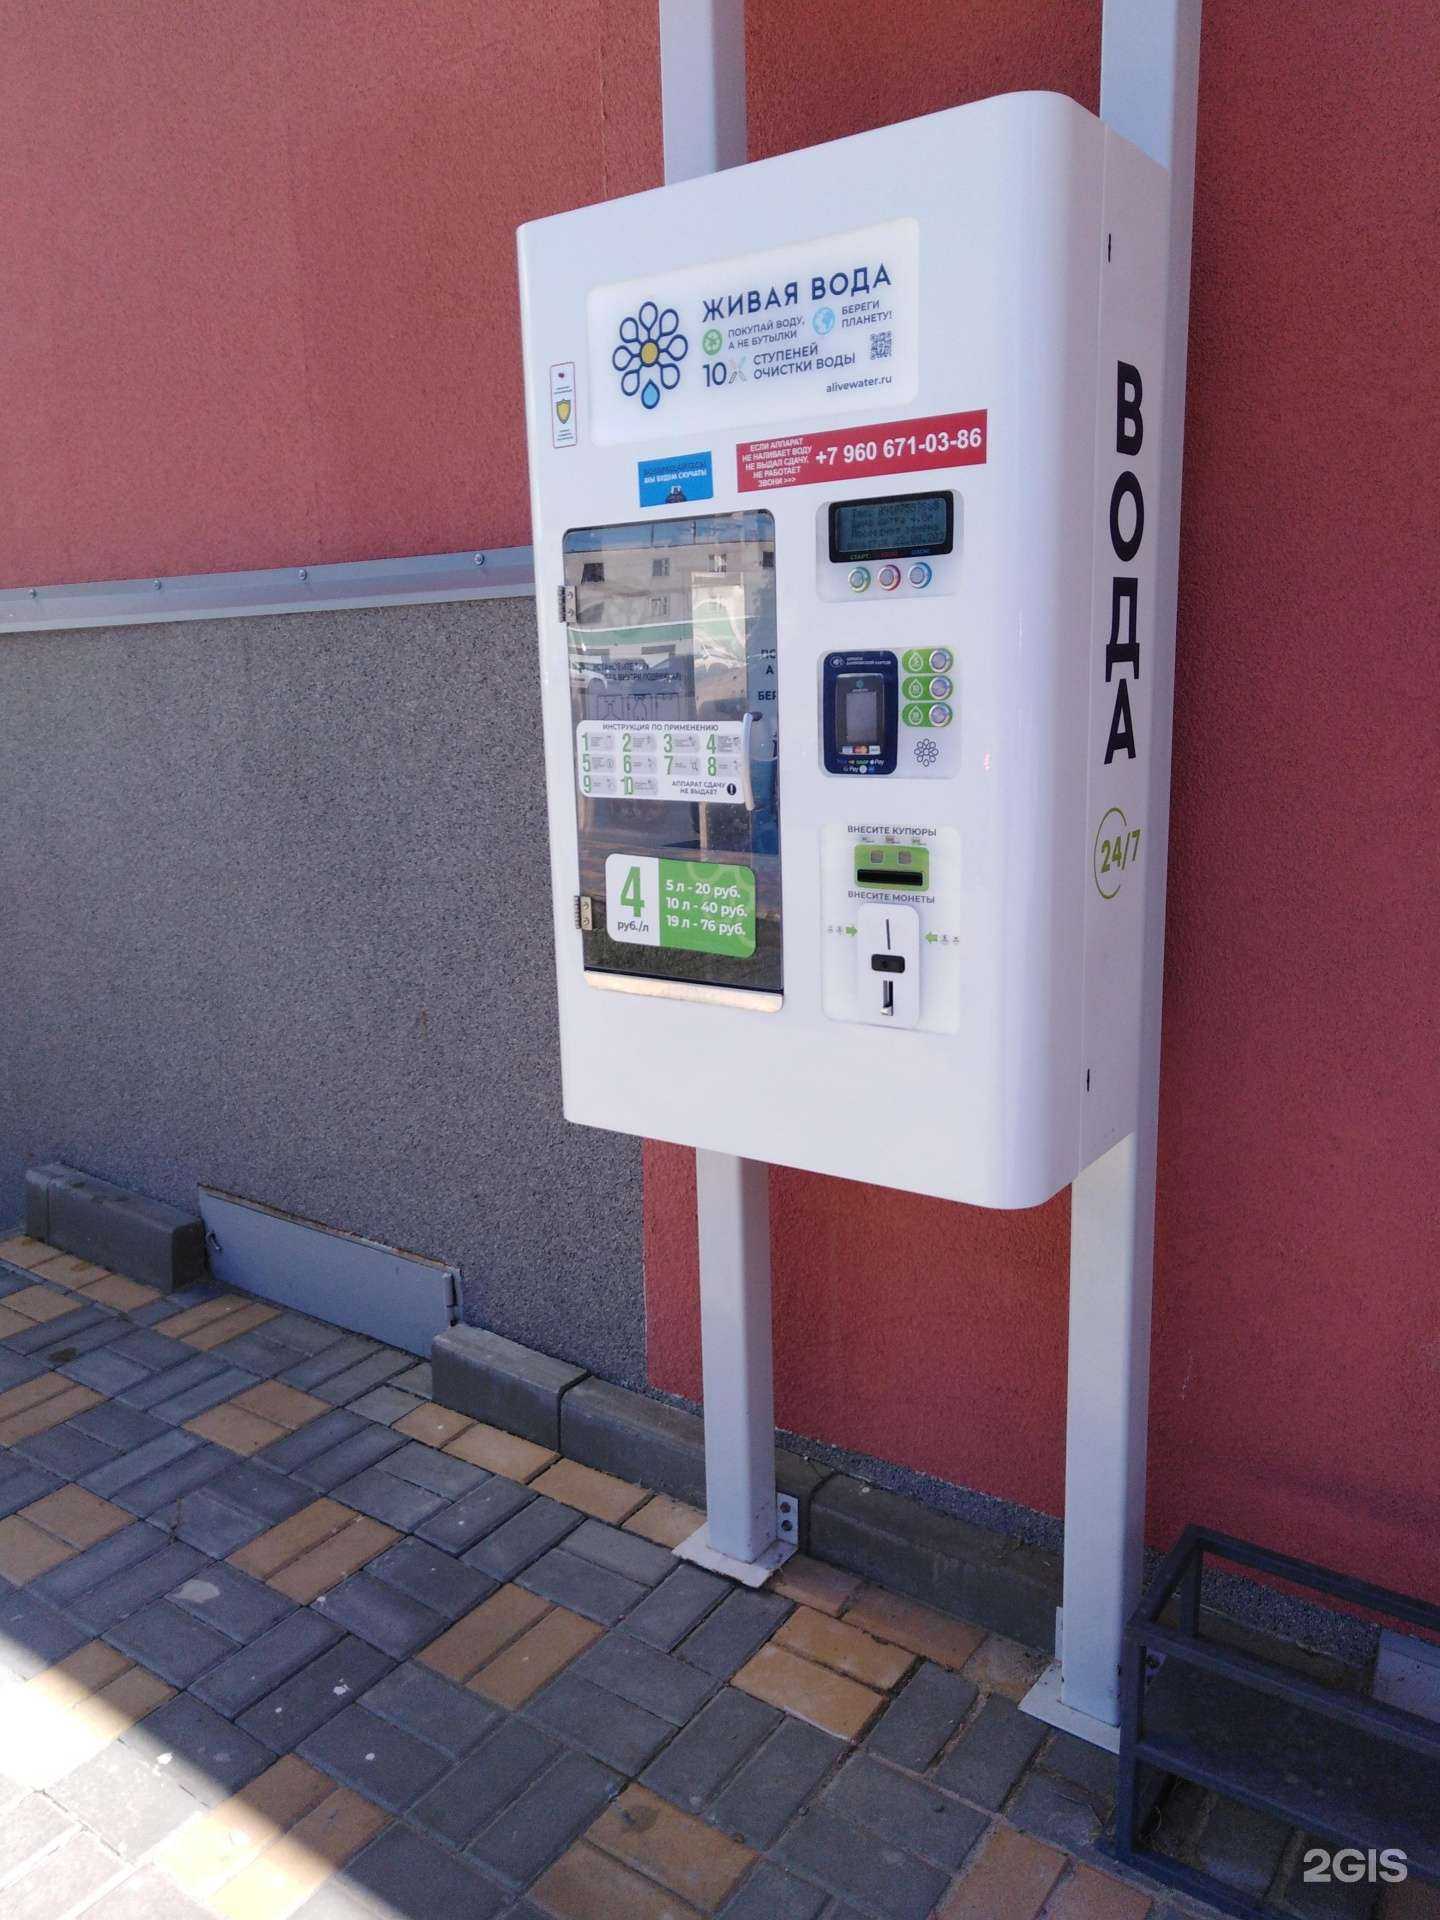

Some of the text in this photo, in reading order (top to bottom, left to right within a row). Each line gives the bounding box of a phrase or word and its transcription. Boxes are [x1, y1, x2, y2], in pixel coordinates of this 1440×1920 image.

[702, 263, 891, 322] ЖИВАЯ ВОДА
[841, 300, 880, 315] БЕРЕГИ
[728, 315, 805, 338] ПОКУПАЙ ВОДУ,
[841, 310, 892, 328] ПЛАНЕТУ!
[728, 330, 797, 350] А НЕ БУТЫЛКИ
[753, 342, 818, 365] СТУПЕНЕЙ
[753, 353, 855, 379] ОЧИСТКИ ВОДЫ
[826, 376, 892, 392] alivewater.ru
[816, 428, 982, 466] +7 960 671-03-86
[1104, 359, 1145, 765] ВОДА
[603, 723, 650, 732] ИНСТРУКЦИЯ
[664, 724, 719, 732] ПРИМЕНЕНИЮ
[581, 733, 588, 751] 1
[623, 733, 632, 752] 2
[664, 733, 673, 753] 3
[706, 734, 717, 754] 4
[583, 754, 591, 772] 5
[623, 755, 632, 774] 6
[664, 755, 674, 775] 7
[708, 756, 717, 776] 8
[583, 776, 592, 793] 9
[672, 780, 702, 788] АППАРАТ
[848, 825, 937, 836] ВНЕСИТЕ КУПЮРЫ
[1101, 829, 1141, 873] 24/7
[620, 866, 645, 917] 4
[666, 880, 674, 891] 5
[676, 883, 684, 892] л
[695, 883, 711, 895] 20
[714, 886, 741, 898] руб.
[848, 891, 935, 904] ВНЕСИТЕ МОНЕТЫ
[666, 897, 679, 909] 10
[681, 902, 690, 911] л
[701, 901, 718, 914] 40
[721, 905, 748, 917] руб.
[617, 920, 649, 932] руб./л
[666, 915, 680, 927] 19
[681, 919, 690, 928] л
[701, 920, 716, 932] 76
[719, 923, 746, 936] руб.
